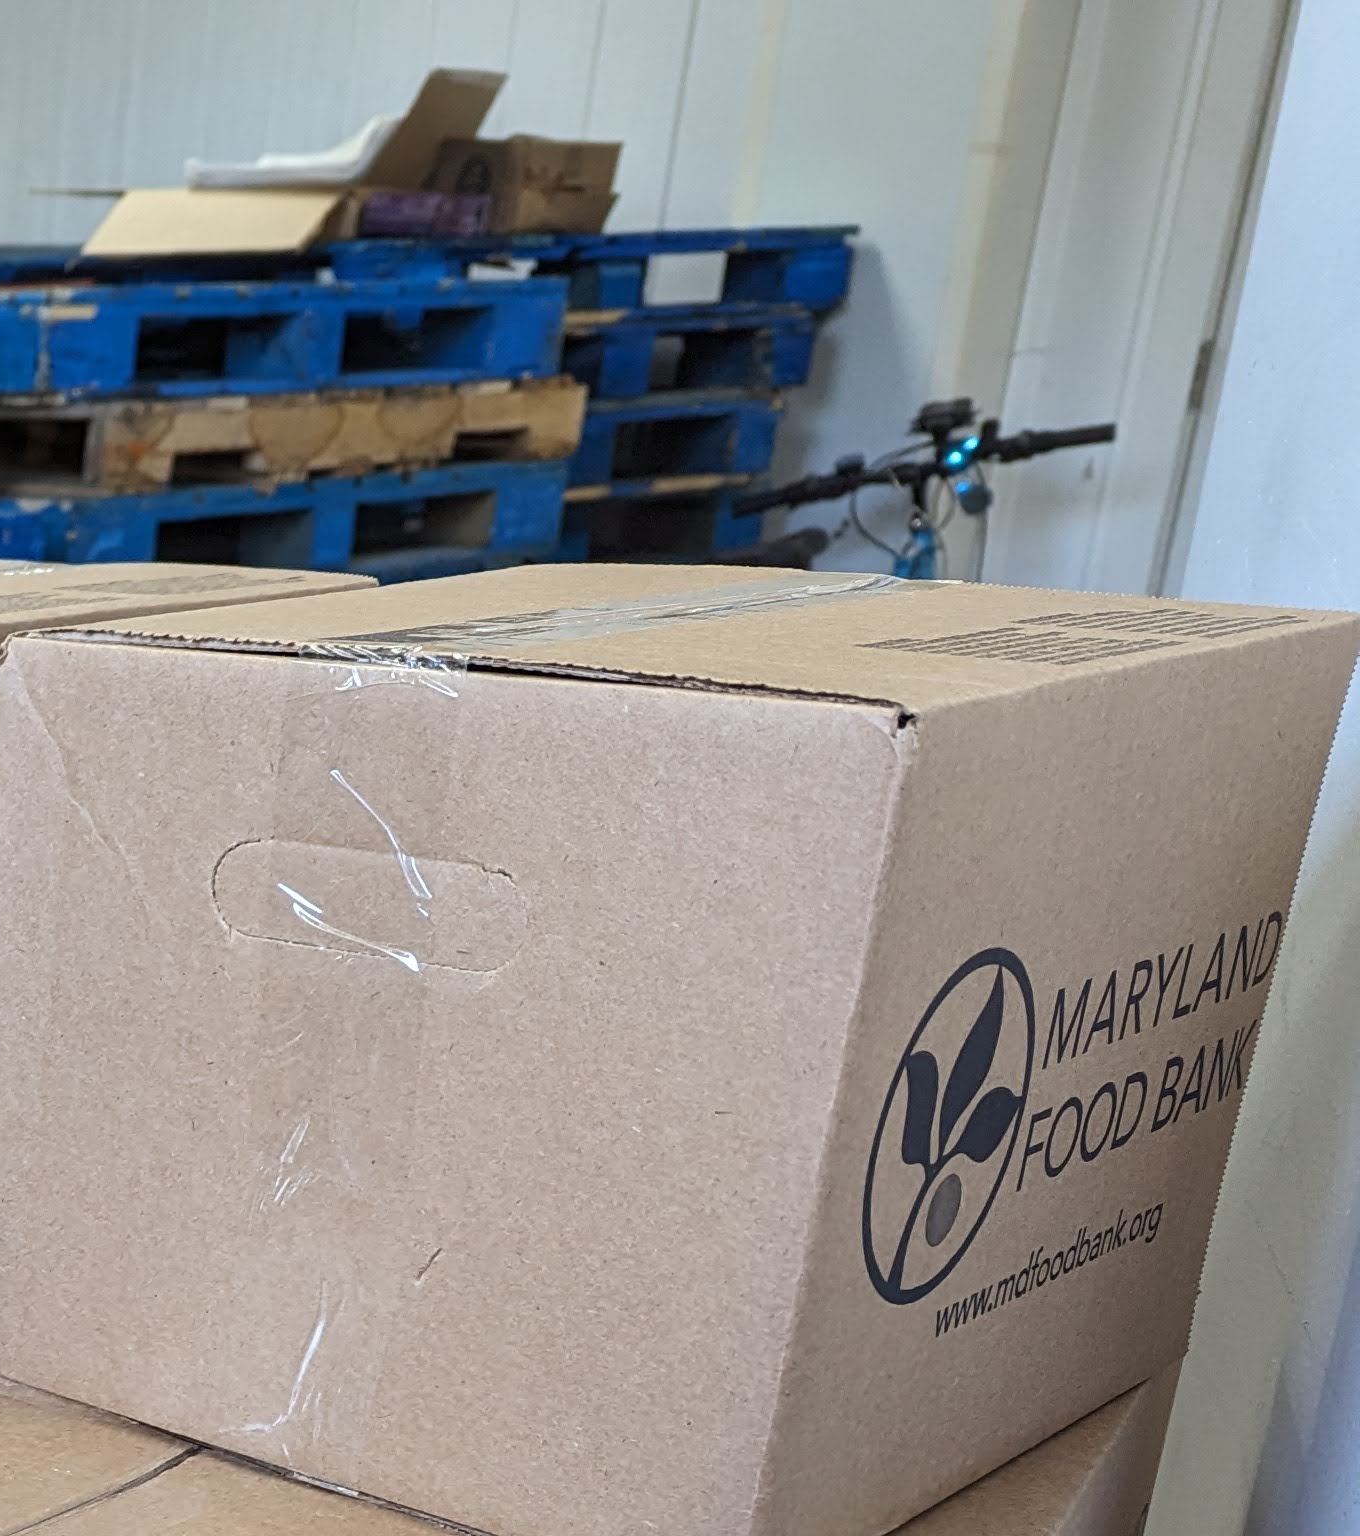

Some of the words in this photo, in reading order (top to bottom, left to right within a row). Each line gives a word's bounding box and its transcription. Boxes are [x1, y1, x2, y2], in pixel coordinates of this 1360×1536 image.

[1042, 911, 1283, 1070] MARYLAND
[1016, 1071, 1149, 1192] FOOD
[1150, 1018, 1259, 1134] BANK
[934, 1201, 1165, 1338] www.mdfoodbank.org
